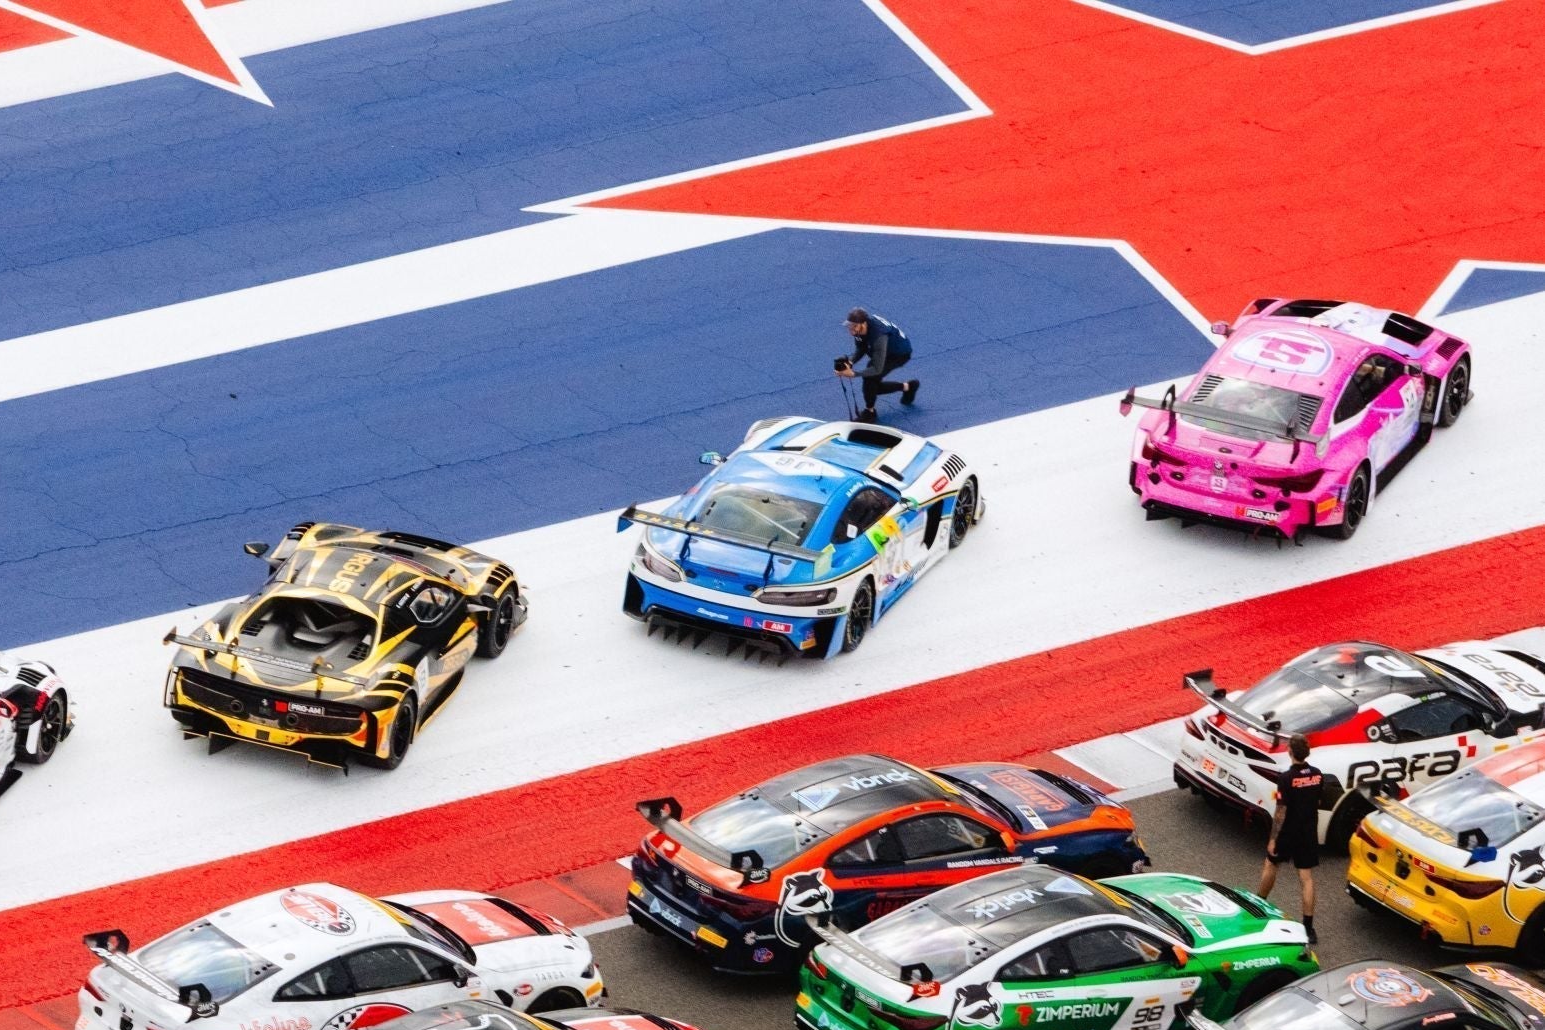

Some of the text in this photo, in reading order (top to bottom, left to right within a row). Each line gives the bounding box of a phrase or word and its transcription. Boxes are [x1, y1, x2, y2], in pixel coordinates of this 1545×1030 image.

[1247, 509, 1279, 521] PRO-AM
[290, 703, 326, 715] PRO-AM
[843, 768, 919, 792] vbrick
[1232, 956, 1281, 971] ZIMPERIUM
[1018, 989, 1055, 999] HTEC
[1036, 1001, 1120, 1023] ZIMPERIUM
[1132, 1004, 1165, 1025] 98
